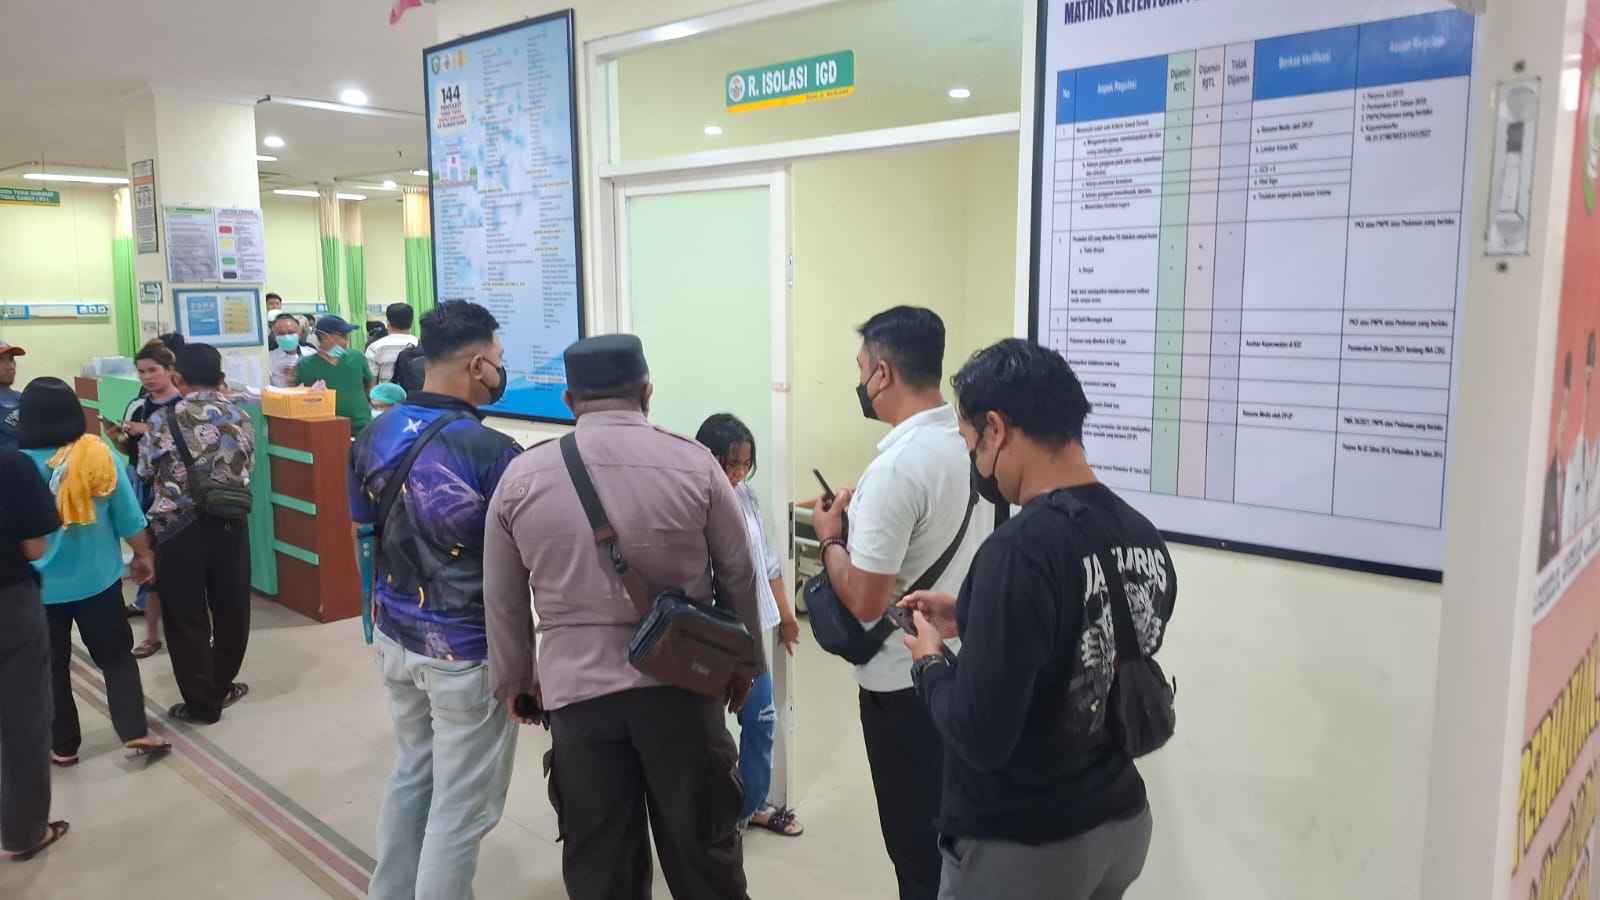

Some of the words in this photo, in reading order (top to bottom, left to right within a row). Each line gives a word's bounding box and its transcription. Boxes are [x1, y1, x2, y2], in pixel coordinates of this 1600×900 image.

[1064, 0, 1114, 25] MATRIKS
[1199, 63, 1221, 76] Dijamin
[1231, 60, 1247, 70] Tidak
[748, 75, 759, 97] R.
[762, 65, 808, 95] ISOLASI
[816, 60, 837, 86] IGD
[1170, 67, 1192, 80] Dijamin
[1228, 74, 1250, 86] Dijamin
[441, 85, 460, 103] 144
